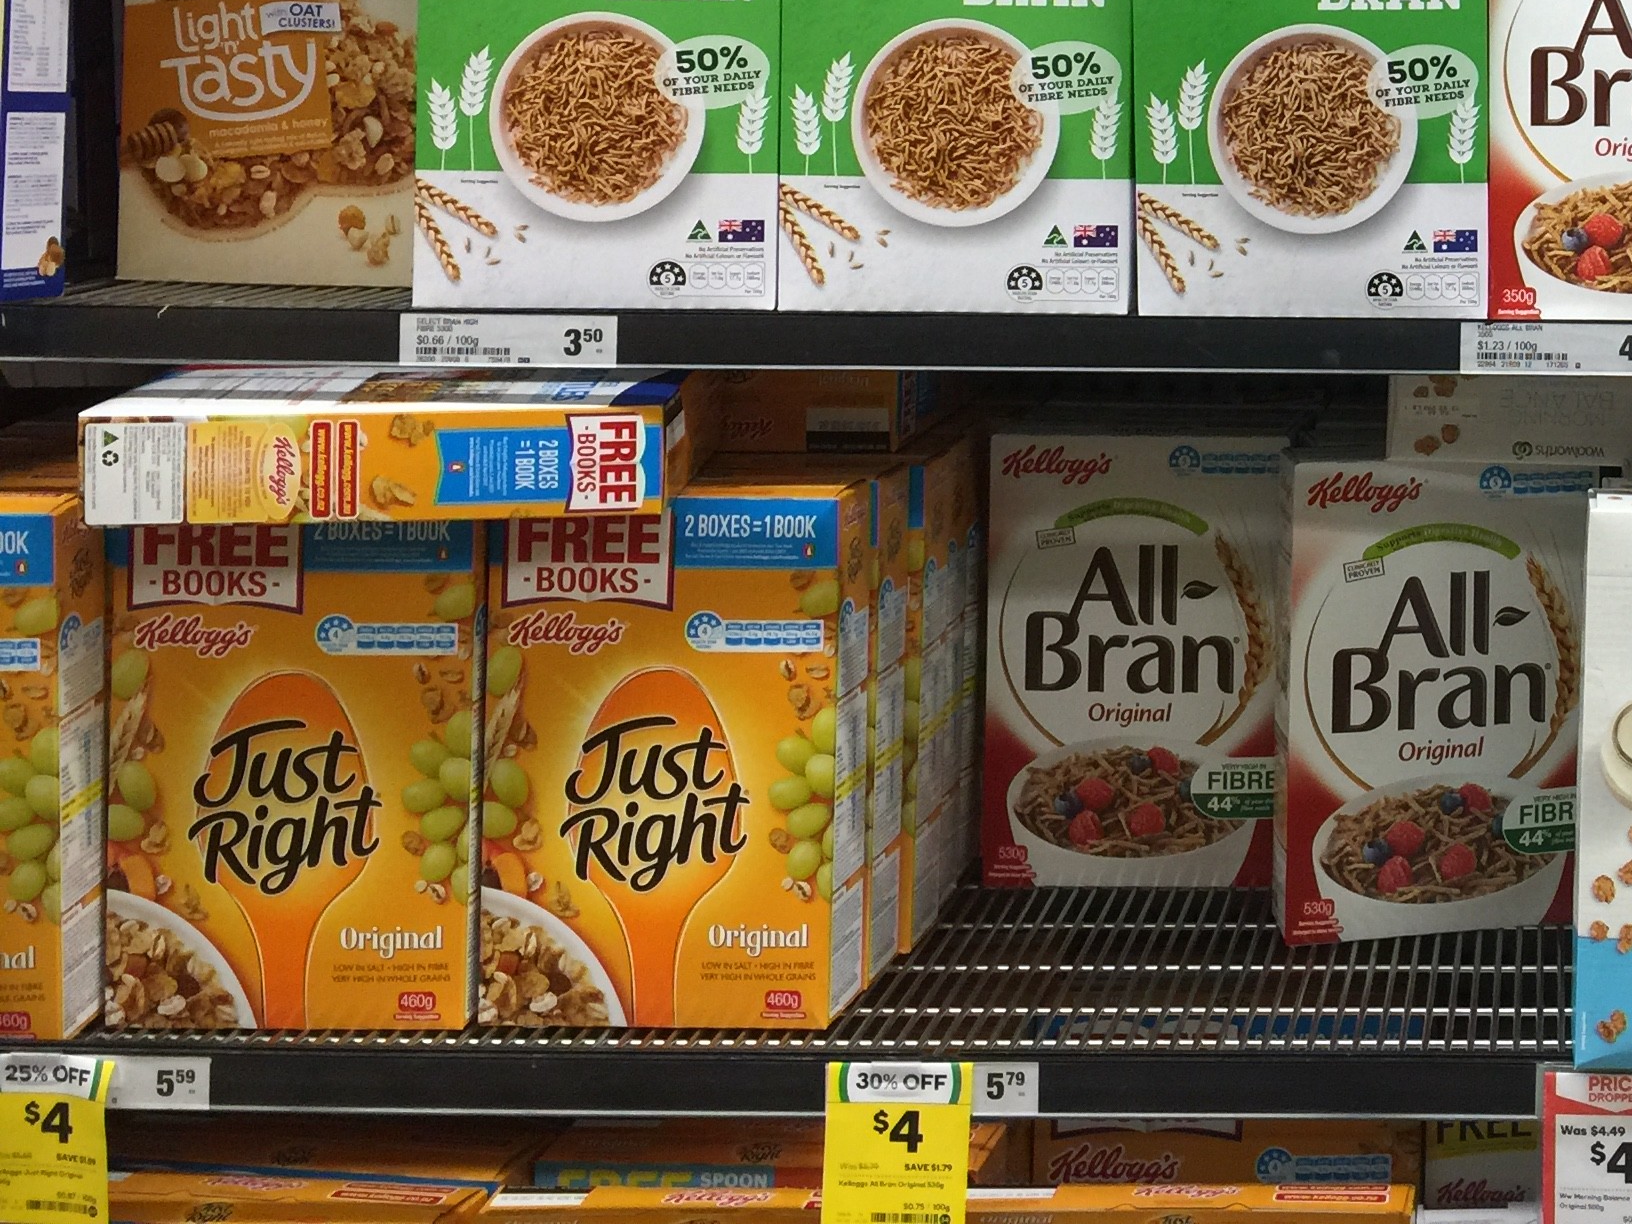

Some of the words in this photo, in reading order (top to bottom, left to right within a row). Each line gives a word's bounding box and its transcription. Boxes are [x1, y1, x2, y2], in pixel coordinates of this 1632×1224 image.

[288, 4, 323, 16] OAT
[278, 16, 336, 29] CLUSTERS!
[675, 45, 749, 73] 50%
[662, 78, 679, 87] OF
[684, 74, 719, 85] YOUR
[723, 70, 762, 81] DAILY
[672, 86, 709, 97] FIBRE
[713, 81, 755, 93] NEEDS
[576, 433, 597, 493] BOOKS
[599, 420, 638, 505] FREE
[134, 614, 255, 656] Kellogg's
[199, 719, 359, 806] Just
[188, 786, 380, 895] Right
[340, 925, 444, 958] Original
[5, 1064, 49, 1083] 25%
[54, 1066, 90, 1086] OFF
[855, 1072, 898, 1091] 30%
[902, 1073, 947, 1091] OFF
[1560, 1125, 1586, 1136] Was
[1589, 1125, 1625, 1137] $4.49
[700, 1171, 769, 1189] SPOON
